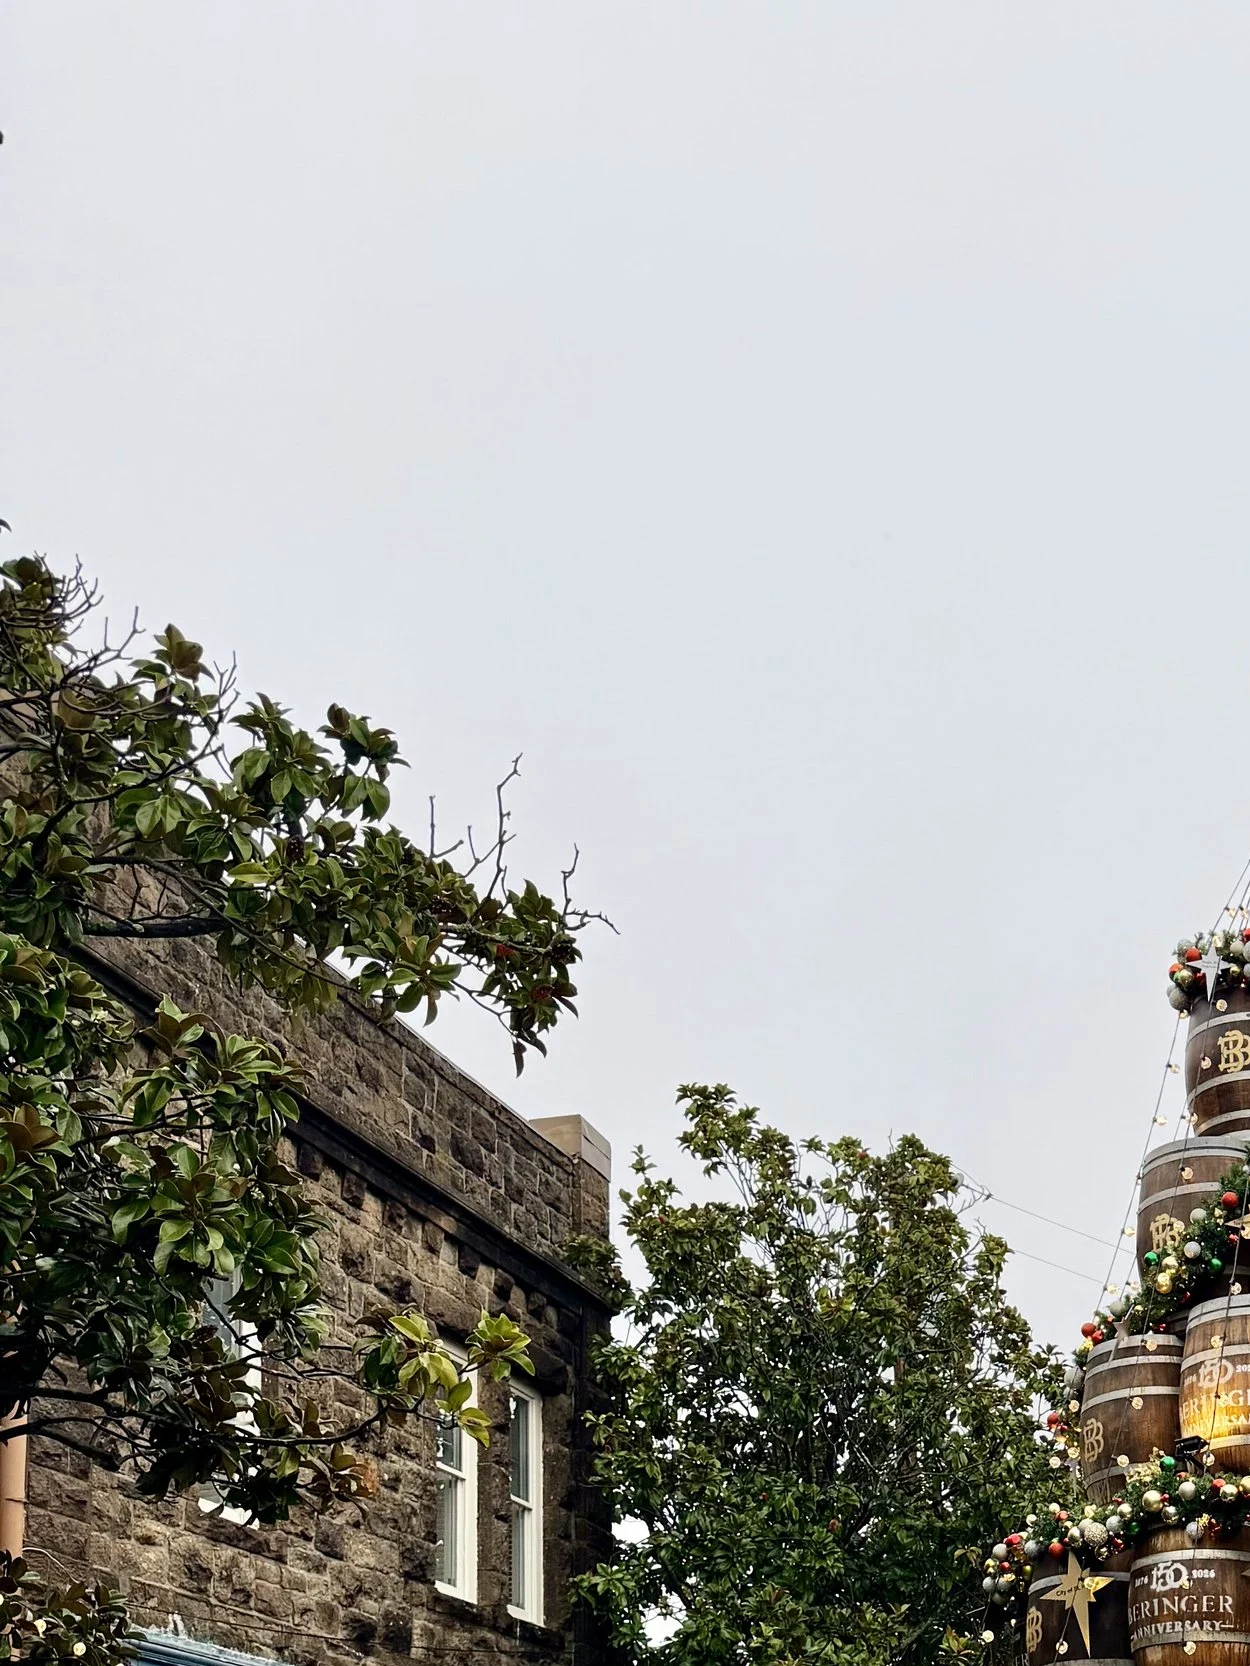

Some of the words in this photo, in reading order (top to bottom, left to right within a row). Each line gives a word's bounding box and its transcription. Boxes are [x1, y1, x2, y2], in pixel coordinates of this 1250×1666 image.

[1192, 1569, 1216, 1579] 2026
[1128, 1595, 1233, 1625] BERINGER
[1133, 1620, 1223, 1640] ANNIVERSARY
